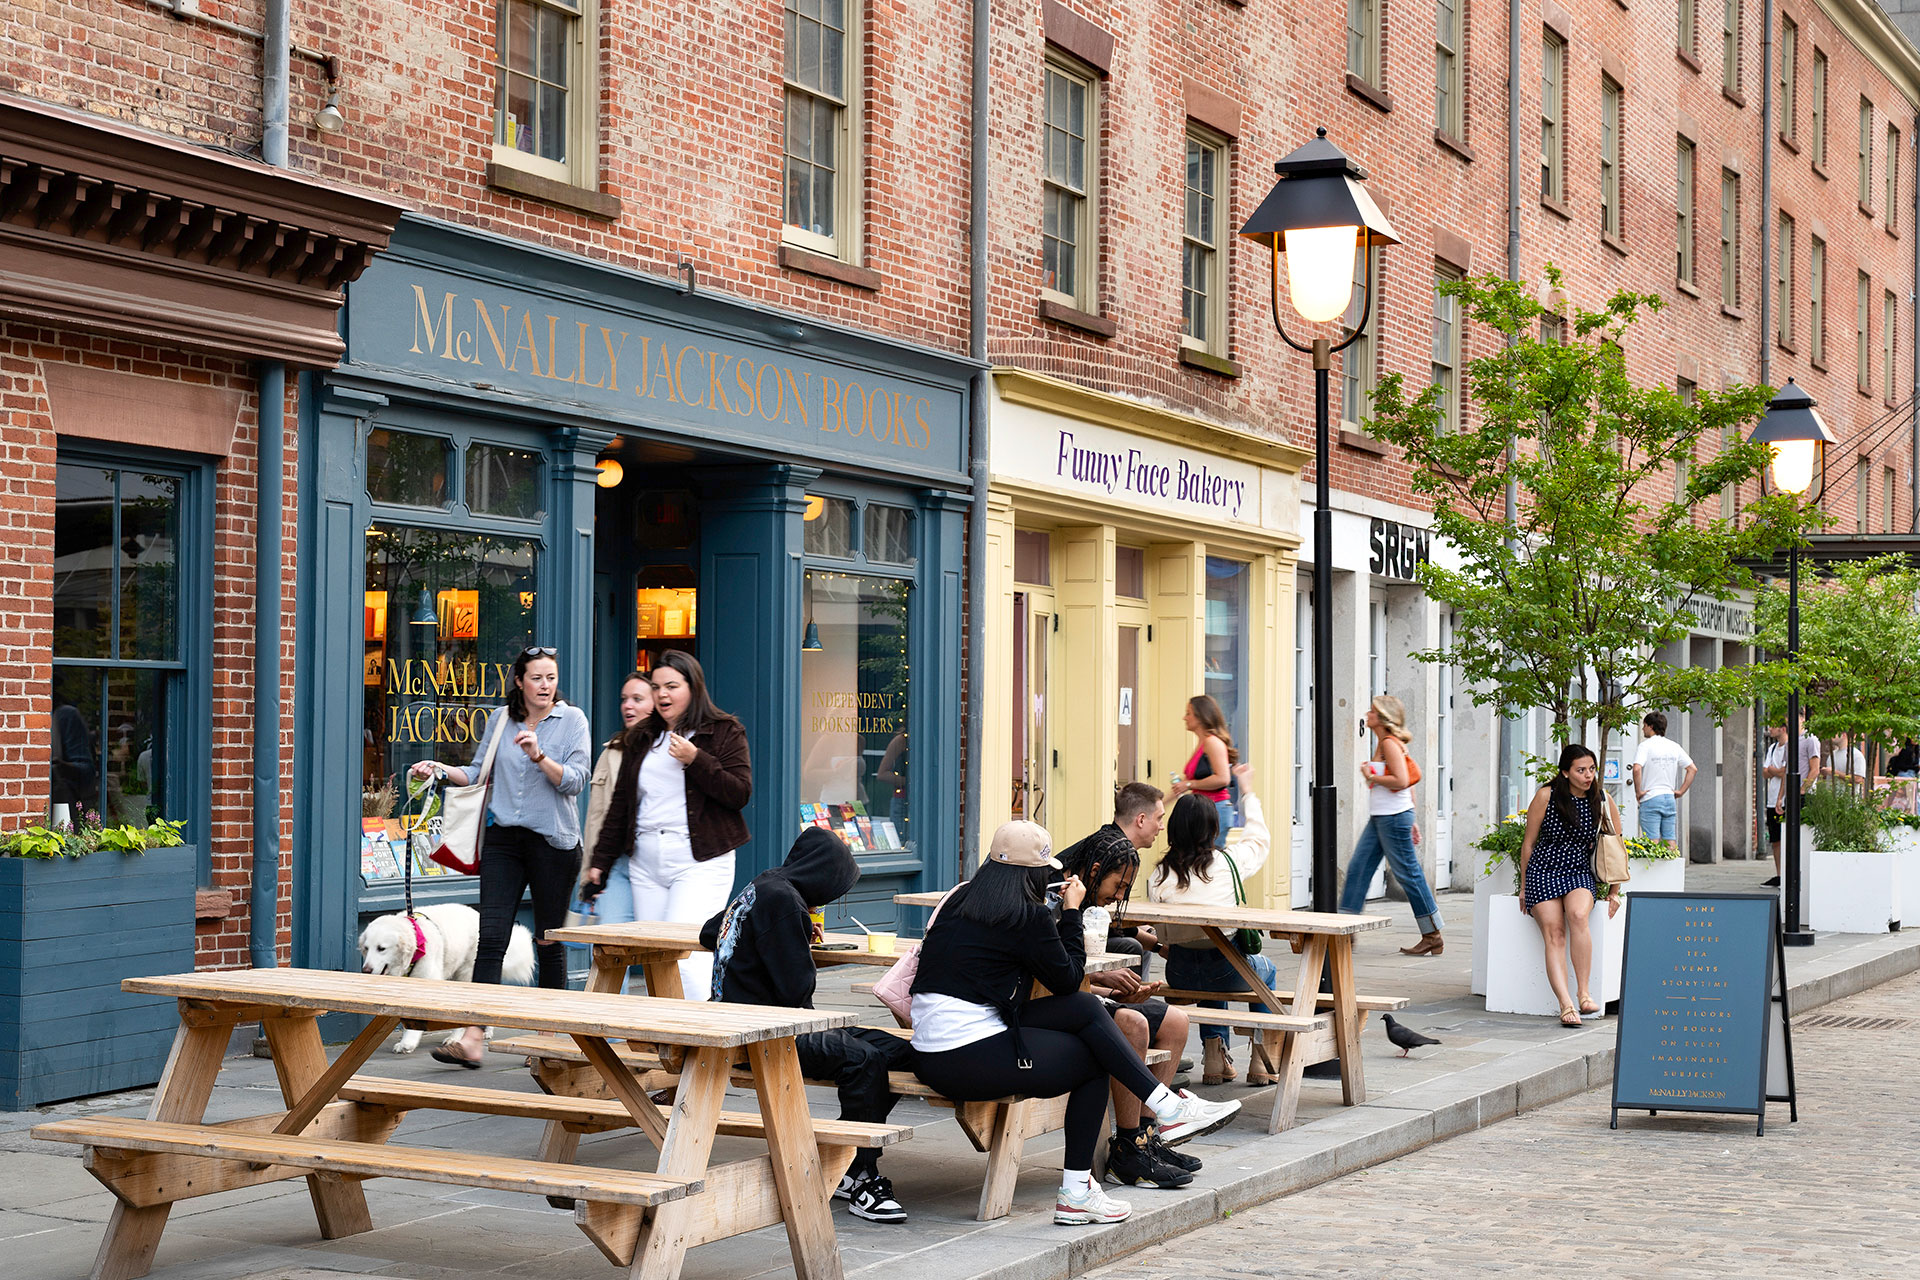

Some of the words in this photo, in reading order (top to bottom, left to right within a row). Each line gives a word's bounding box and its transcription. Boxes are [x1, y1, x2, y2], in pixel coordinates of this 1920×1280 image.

[409, 284, 629, 392] McNALLY
[635, 335, 811, 428] JACKSON
[820, 376, 931, 450] BOOKS
[1057, 430, 1122, 495] Funny
[1125, 449, 1171, 498] Face
[1176, 459, 1245, 517] Bakery
[1369, 517, 1430, 580] SRGN
[1701, 601, 1725, 632] SEAPORT
[1726, 606, 1750, 635] MUSEUM
[387, 658, 512, 698] McNALLY
[811, 692, 894, 709] INDEPENDENT
[1122, 692, 1130, 714] A
[387, 705, 495, 743] JACKSO
[811, 715, 894, 733] BOOKSELLERS
[1686, 1010, 1731, 1018] FLOORS
[1652, 1055, 1728, 1063] IMAGINABLE
[1688, 1090, 1727, 1099] JACKSON
